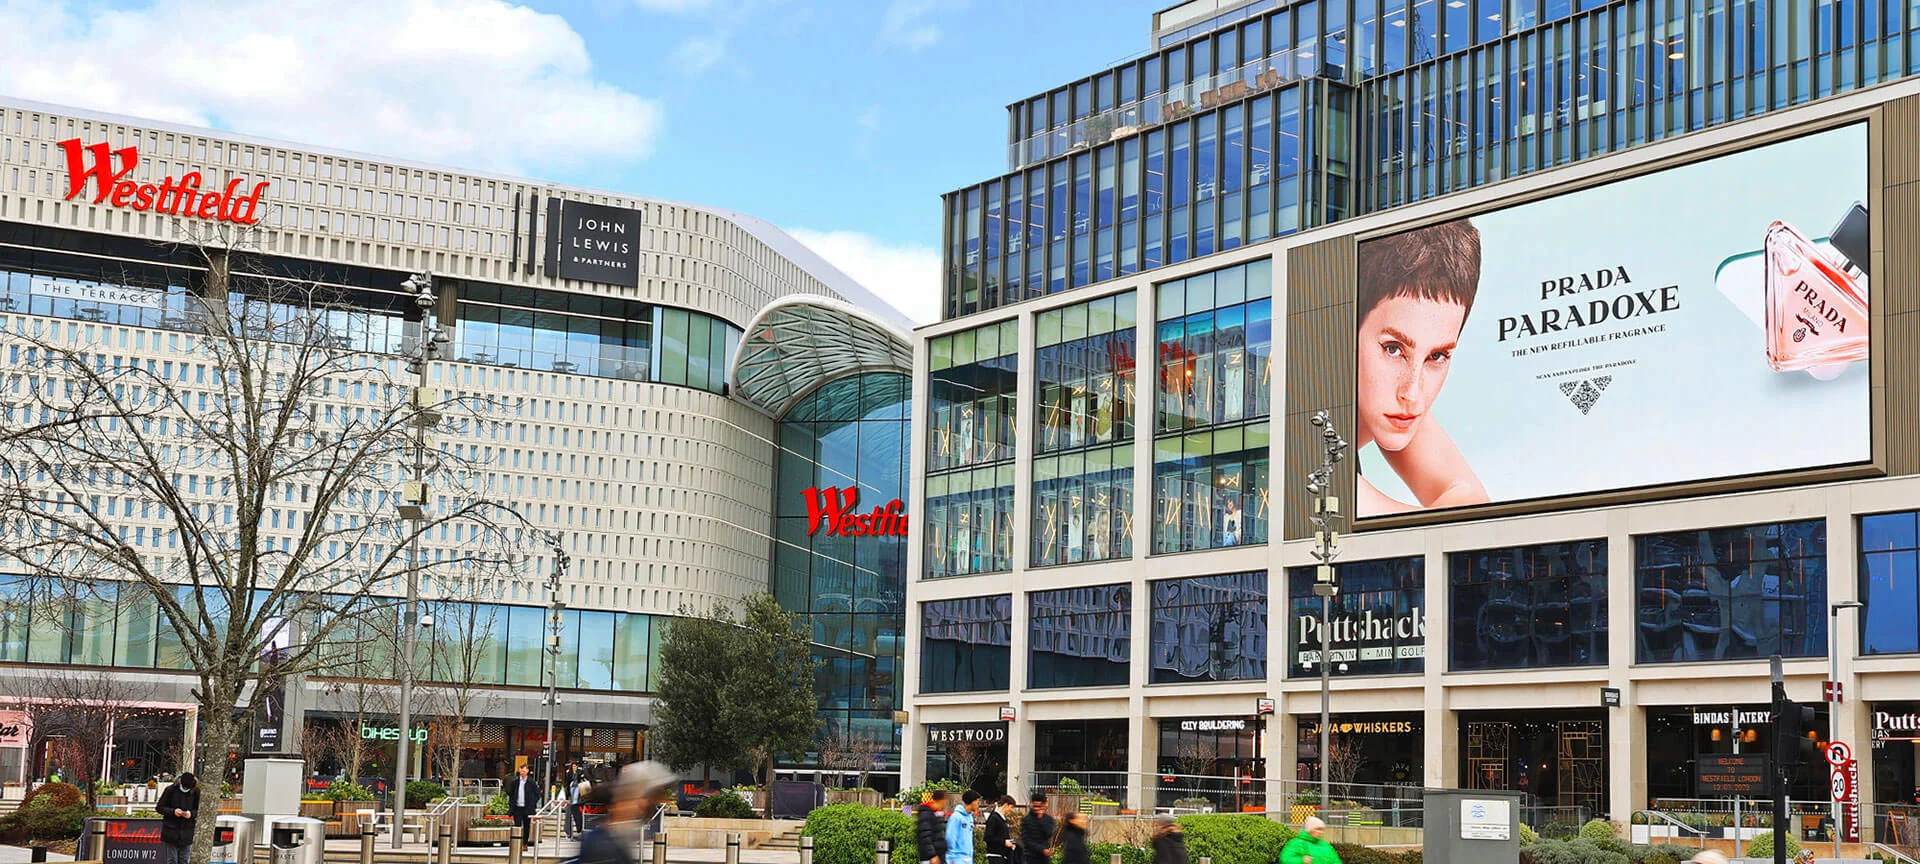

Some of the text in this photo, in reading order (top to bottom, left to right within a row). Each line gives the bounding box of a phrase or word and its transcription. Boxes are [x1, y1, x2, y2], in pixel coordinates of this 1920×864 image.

[57, 138, 270, 225] Westfield
[578, 217, 625, 234] JOHN
[573, 236, 629, 254] LEWIS
[581, 257, 627, 268] PARTNERS
[43, 283, 71, 295] THE
[1541, 266, 1632, 300] PRADA
[1497, 285, 1680, 342] PARADOXE
[1795, 280, 1847, 333] PRADA
[1511, 323, 1667, 358] THE NEW REFILLABLE FRAGRANCE
[800, 485, 909, 537] Westfie
[1299, 607, 1425, 644] Puttshack
[1375, 648, 1393, 658] MIN
[1181, 720, 1245, 730] CITY BOULDERING
[1693, 711, 1770, 724] BINDAS ATERY
[930, 728, 1004, 742] WESTWOOD
[1353, 721, 1412, 734] WHISKERS
[1834, 778, 1845, 793] 20
[1848, 761, 1858, 838] Puttshack
[105, 821, 163, 844] Westfield
[106, 849, 157, 860] LONDON W12
